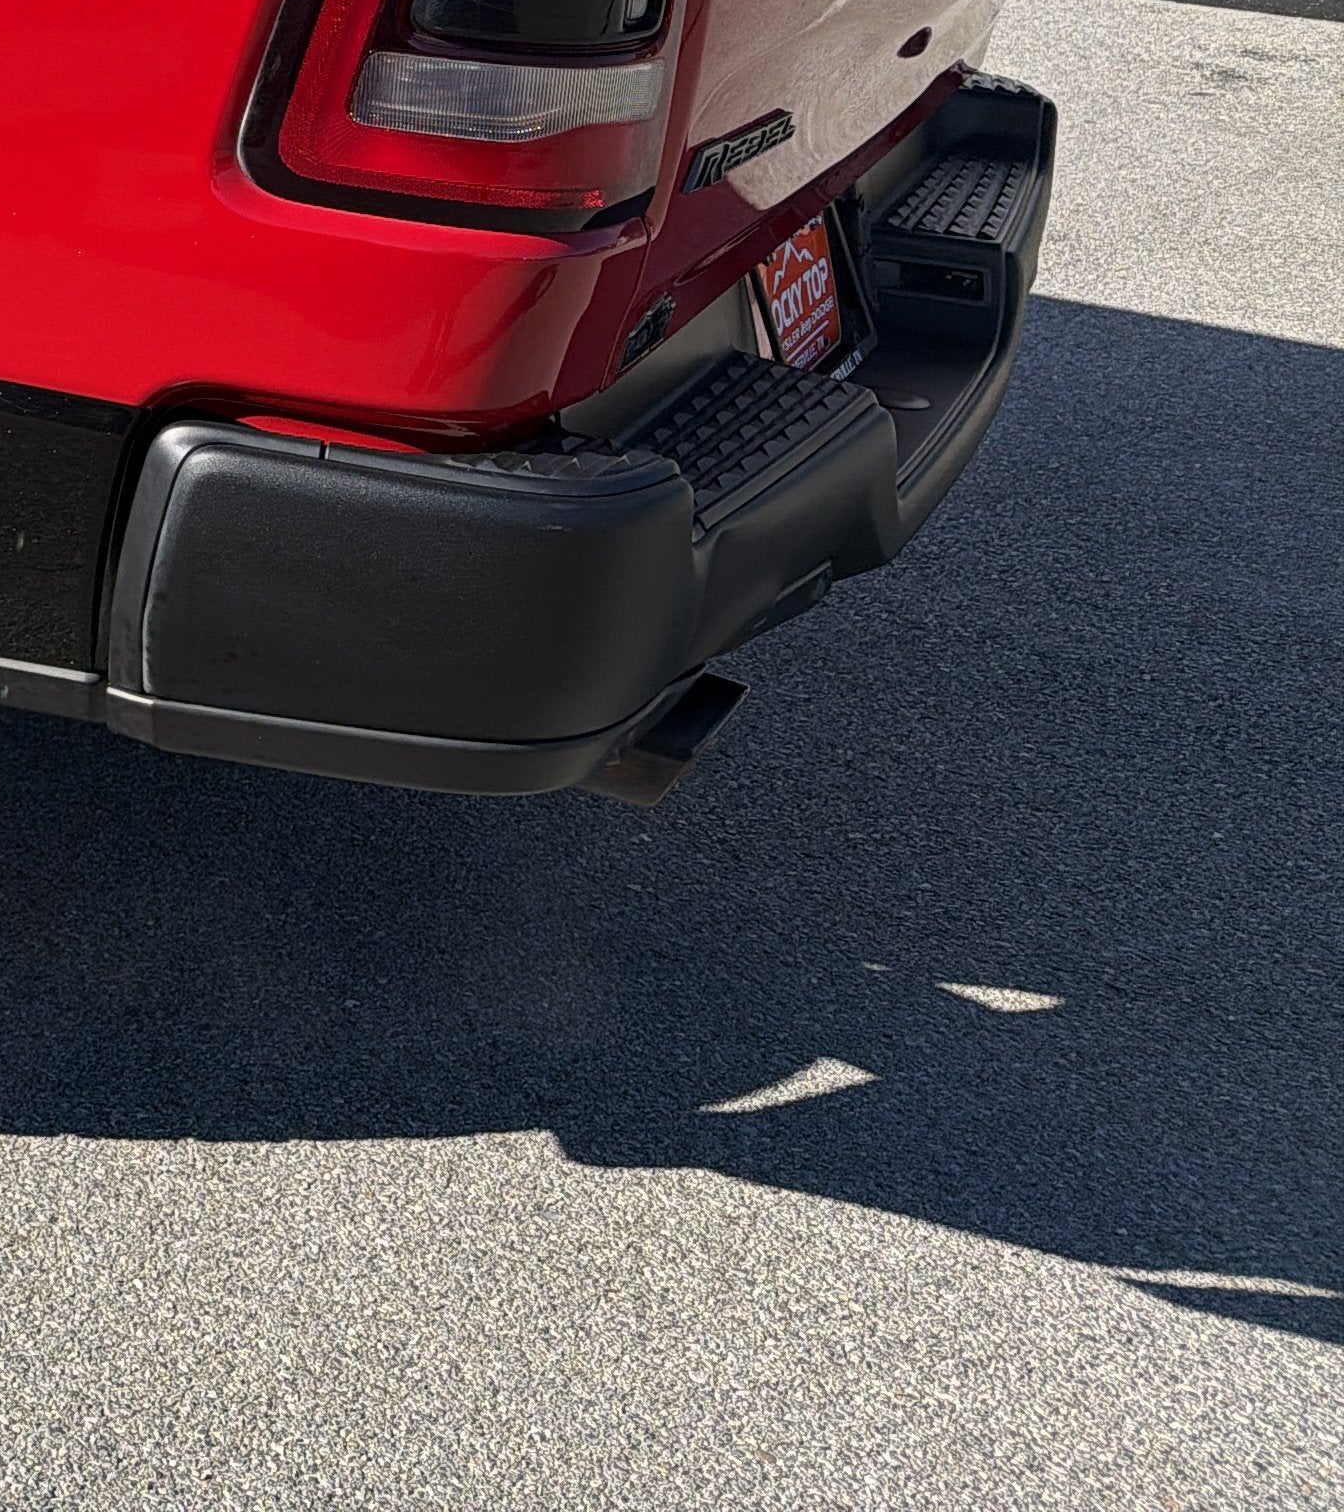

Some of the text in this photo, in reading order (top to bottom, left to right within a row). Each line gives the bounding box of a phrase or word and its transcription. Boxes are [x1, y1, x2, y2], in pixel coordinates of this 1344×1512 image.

[683, 110, 796, 194] REBEL
[771, 257, 829, 336] OCKY TOP
[812, 295, 835, 324] DODGE
